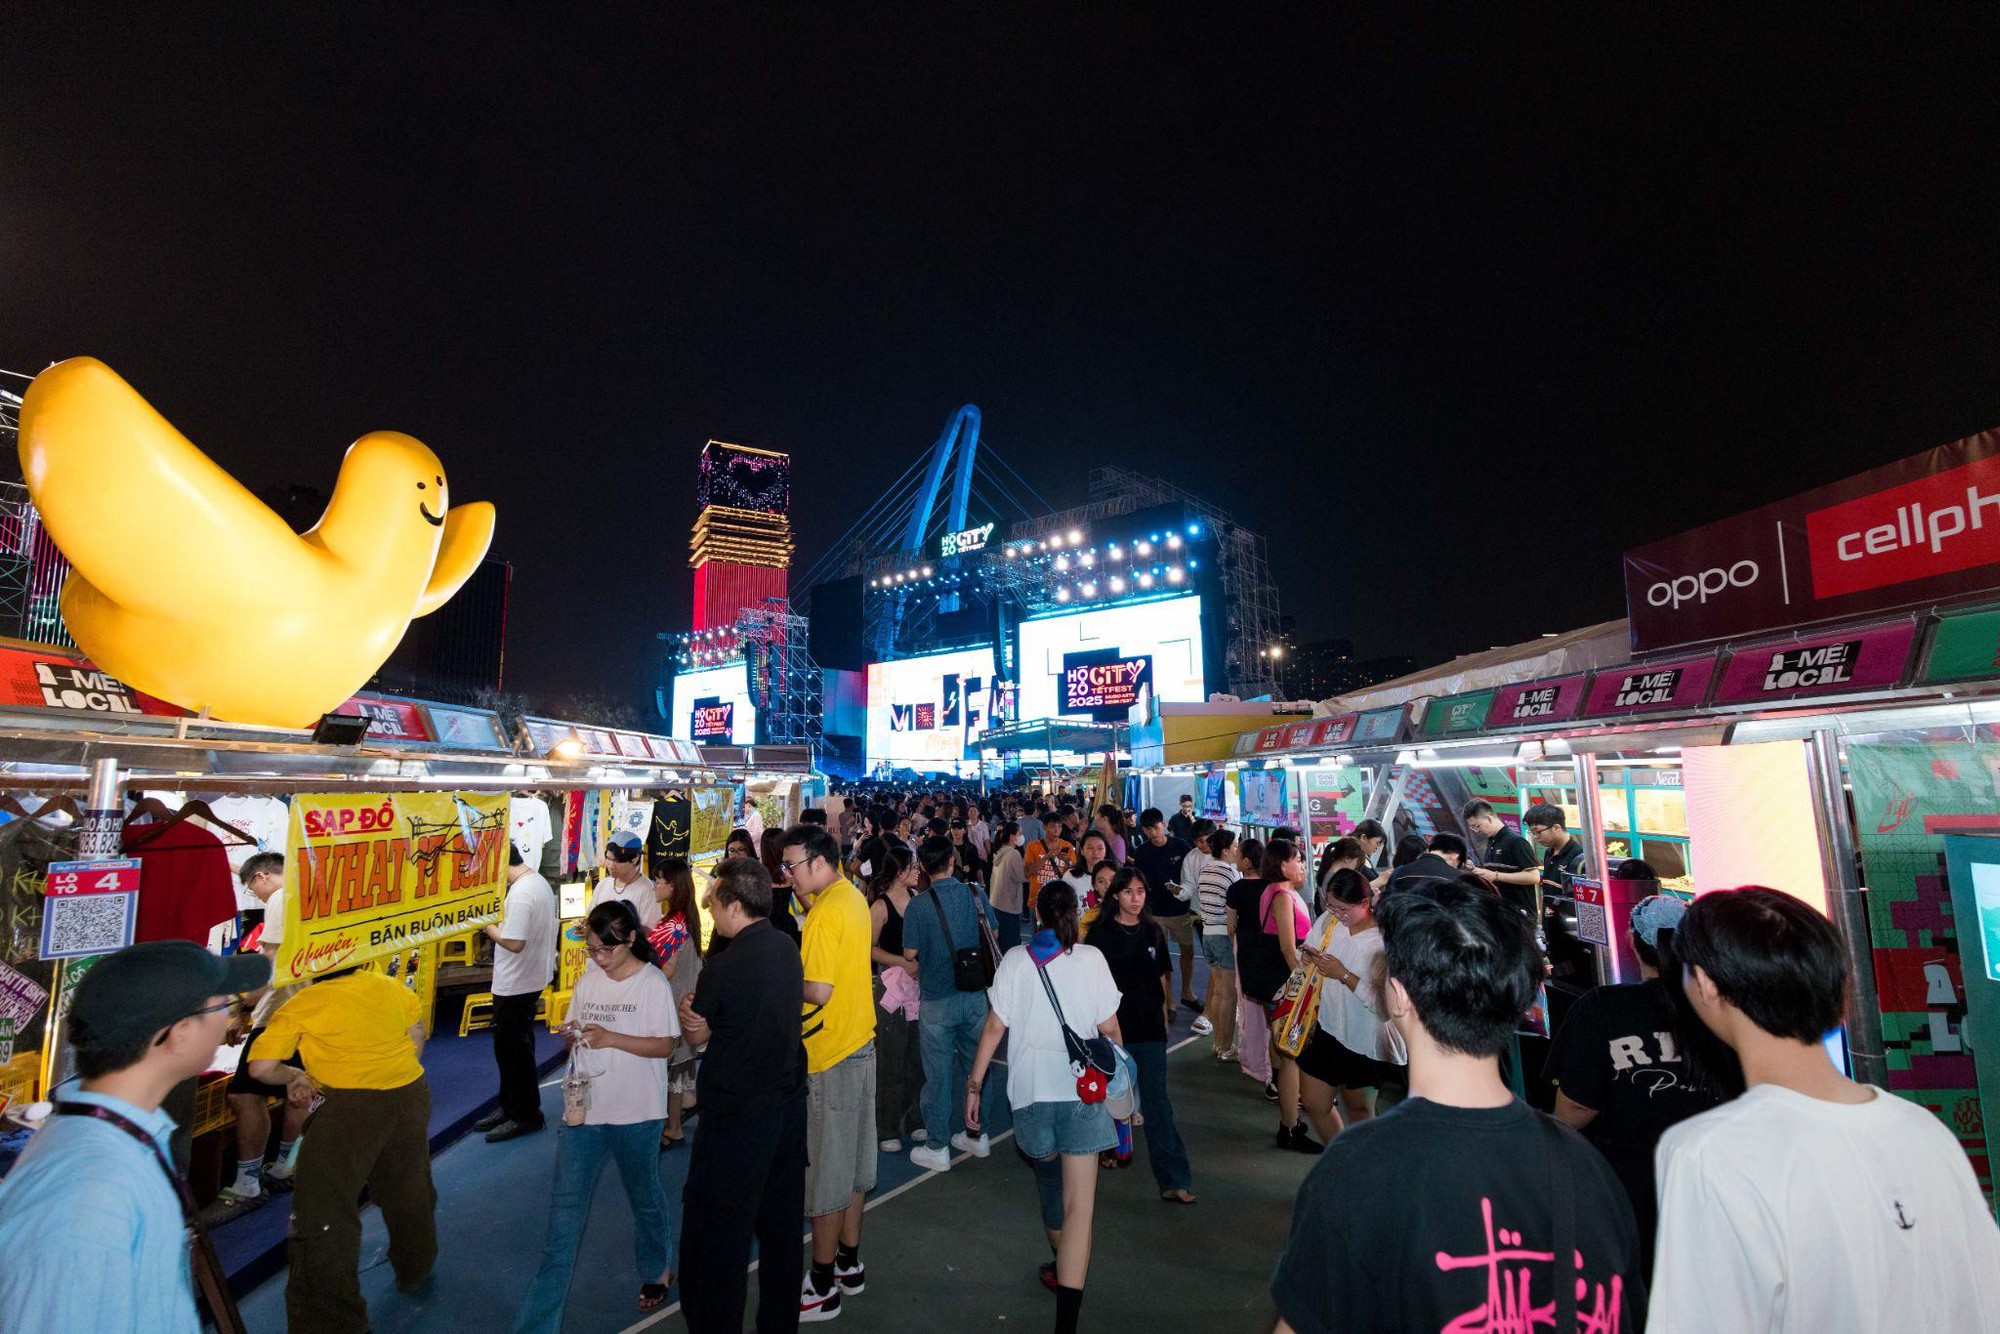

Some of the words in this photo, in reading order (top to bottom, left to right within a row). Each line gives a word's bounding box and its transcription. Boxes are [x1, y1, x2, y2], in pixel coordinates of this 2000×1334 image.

[1647, 560, 1759, 610] oppo
[1762, 666, 1851, 691] LOCAL
[42, 687, 142, 714] LOCAL
[1067, 696, 1103, 708] 2025
[1614, 688, 1673, 707] LOCAL
[95, 872, 121, 890] 4
[297, 837, 411, 922] WHAT
[1589, 889, 1598, 902] 7
